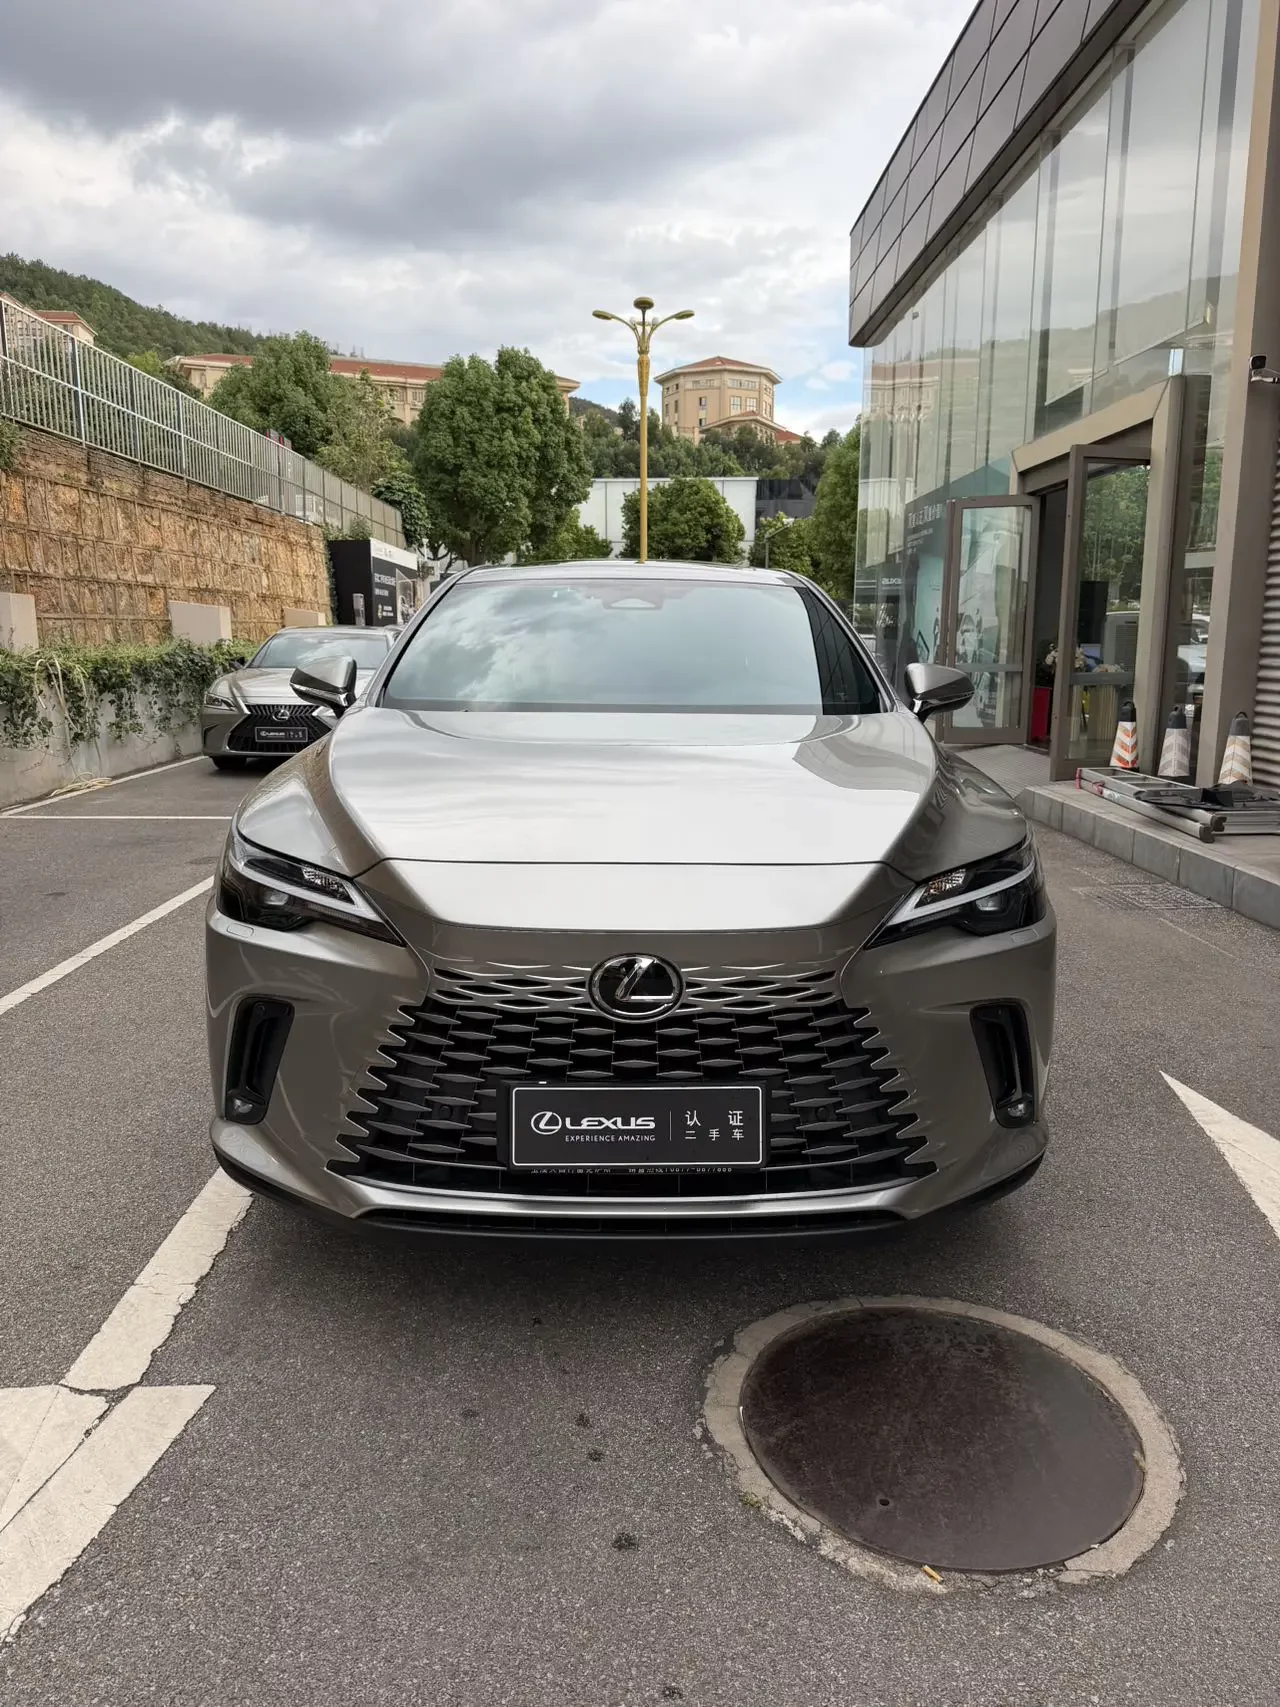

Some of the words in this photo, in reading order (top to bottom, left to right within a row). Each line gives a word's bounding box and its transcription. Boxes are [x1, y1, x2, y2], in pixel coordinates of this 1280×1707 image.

[565, 1117, 656, 1129] LEXUS
[684, 1128, 745, 1141] 二手车
